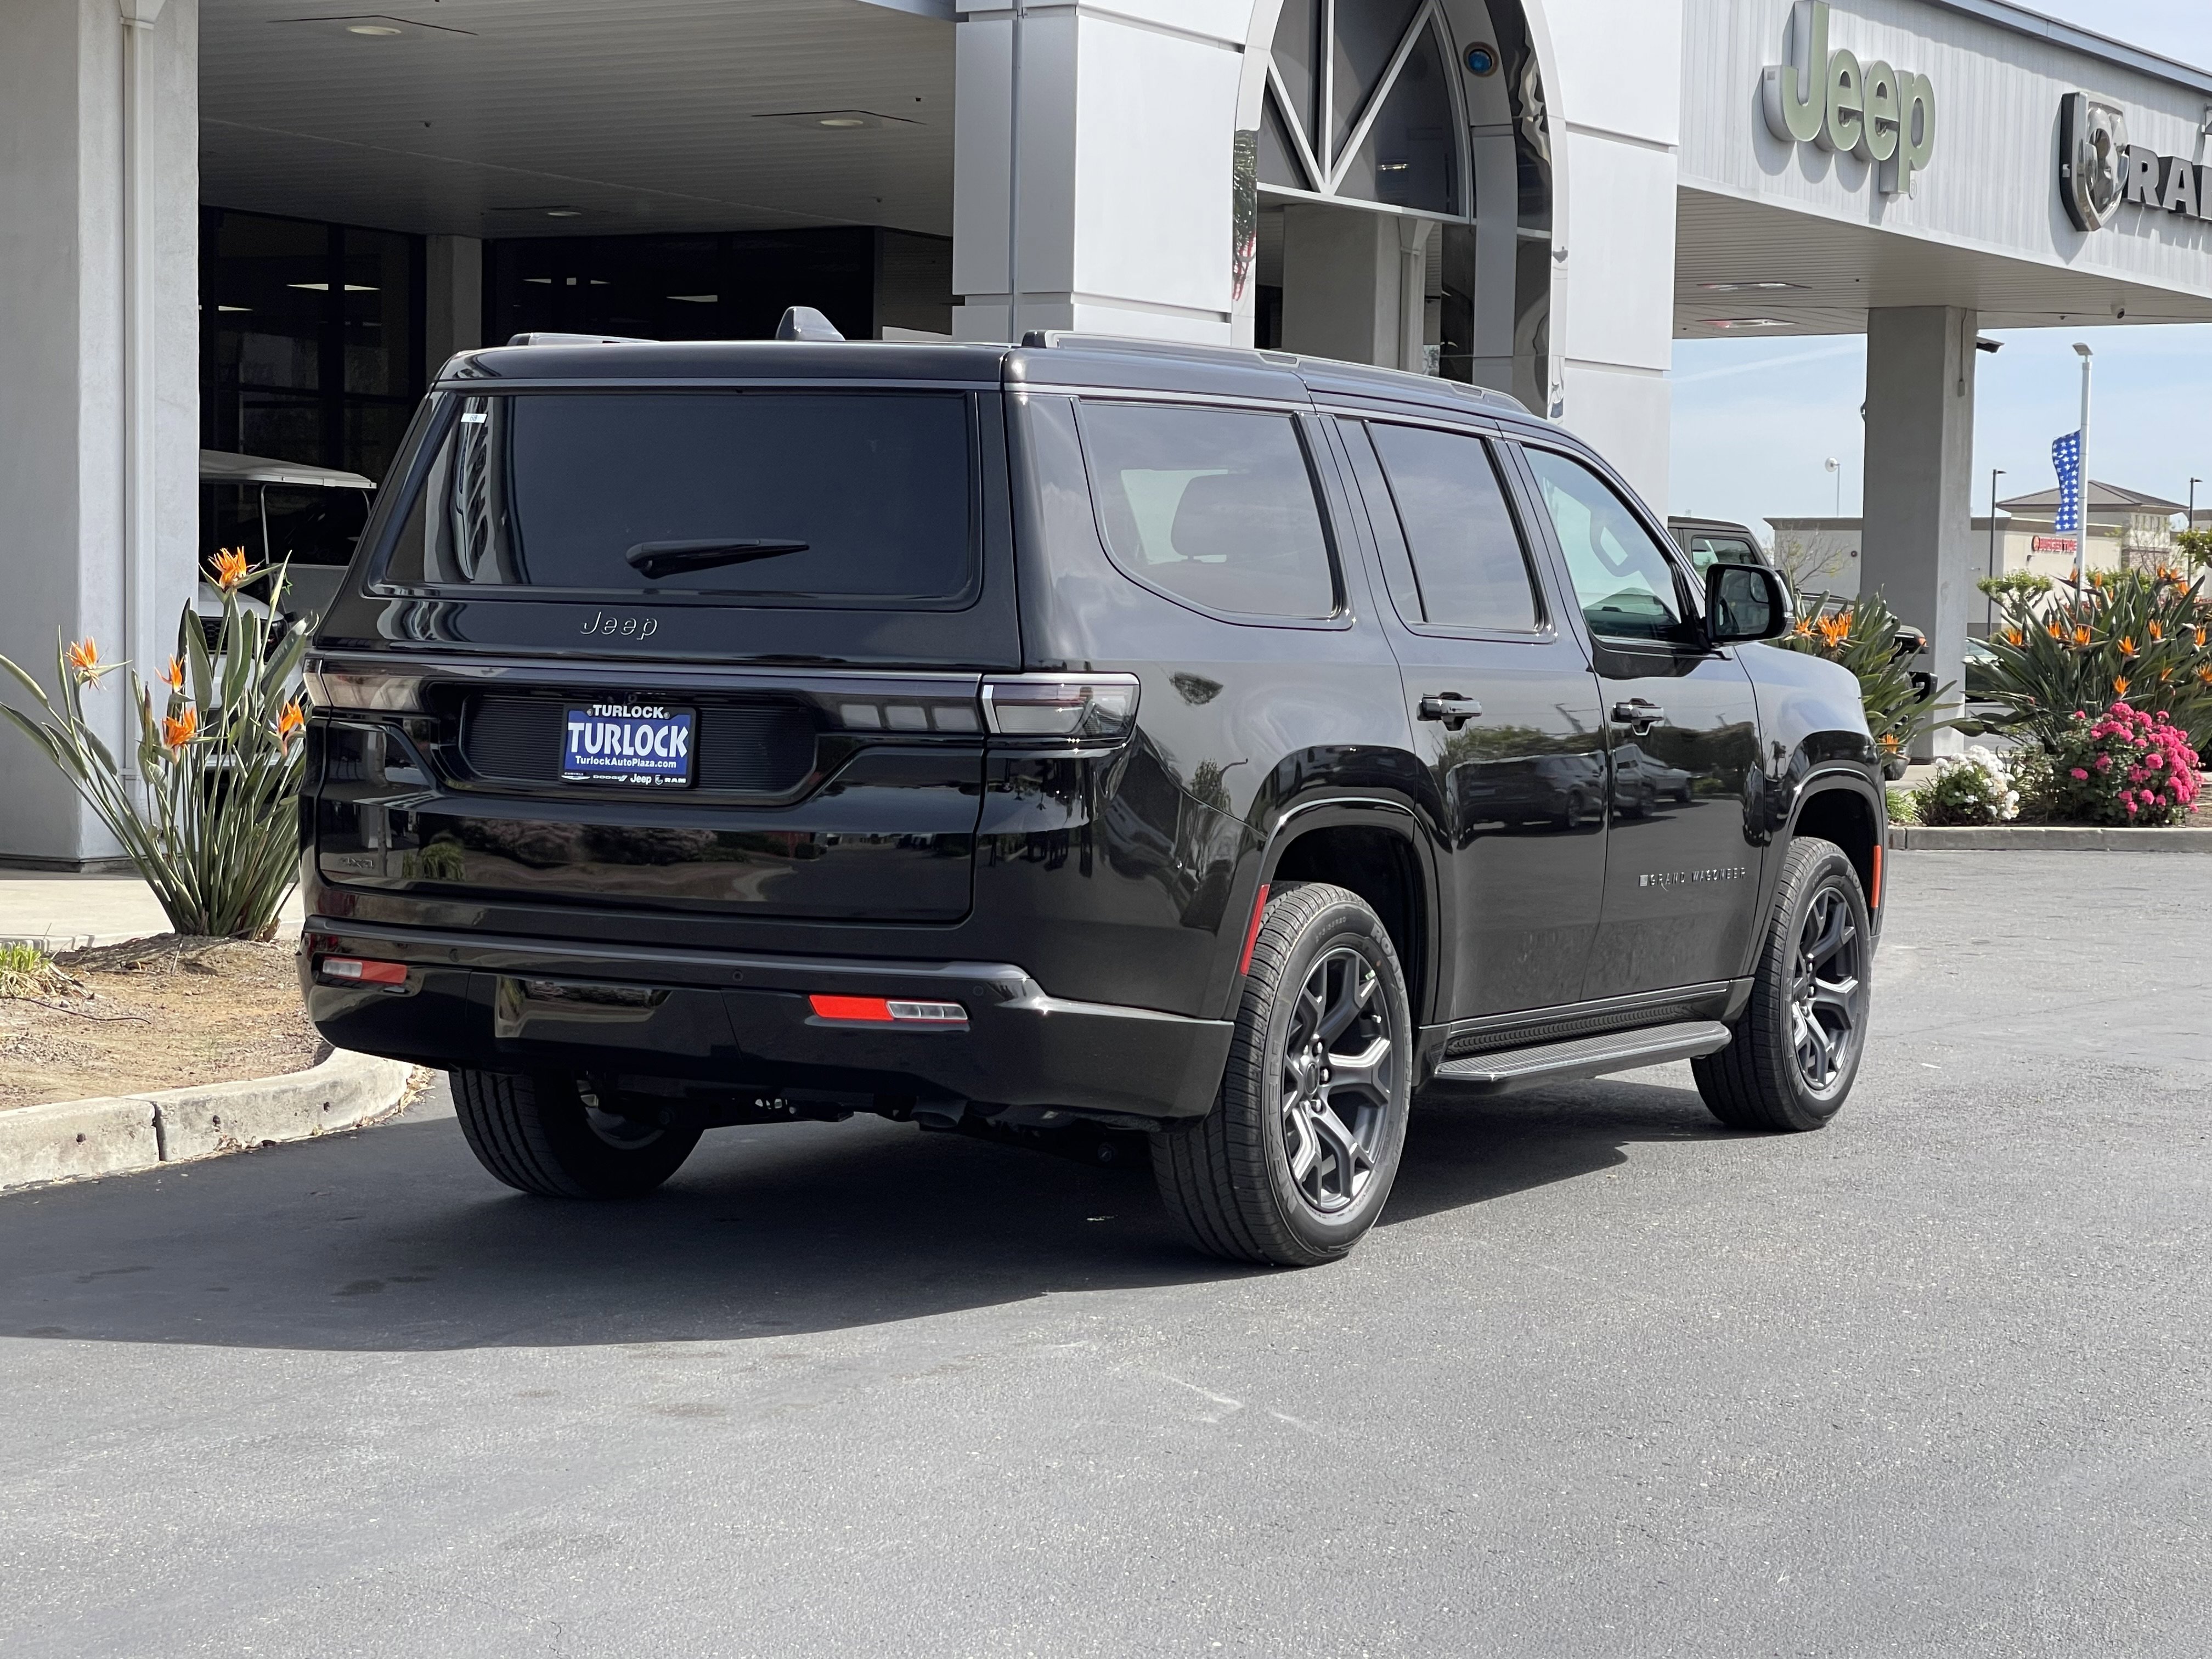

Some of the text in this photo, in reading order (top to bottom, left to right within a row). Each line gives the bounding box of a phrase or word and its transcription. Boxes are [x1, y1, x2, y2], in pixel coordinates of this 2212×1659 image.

[1763, 1, 1936, 194] Jeep
[580, 611, 658, 640] Jeep
[592, 704, 664, 719] TURLOCK
[568, 722, 689, 758] TURLOCK
[575, 755, 677, 769] TurlockAutoPlaza.com
[630, 773, 652, 786] Jeep
[1650, 867, 1746, 885] GRAND WAGONEER
